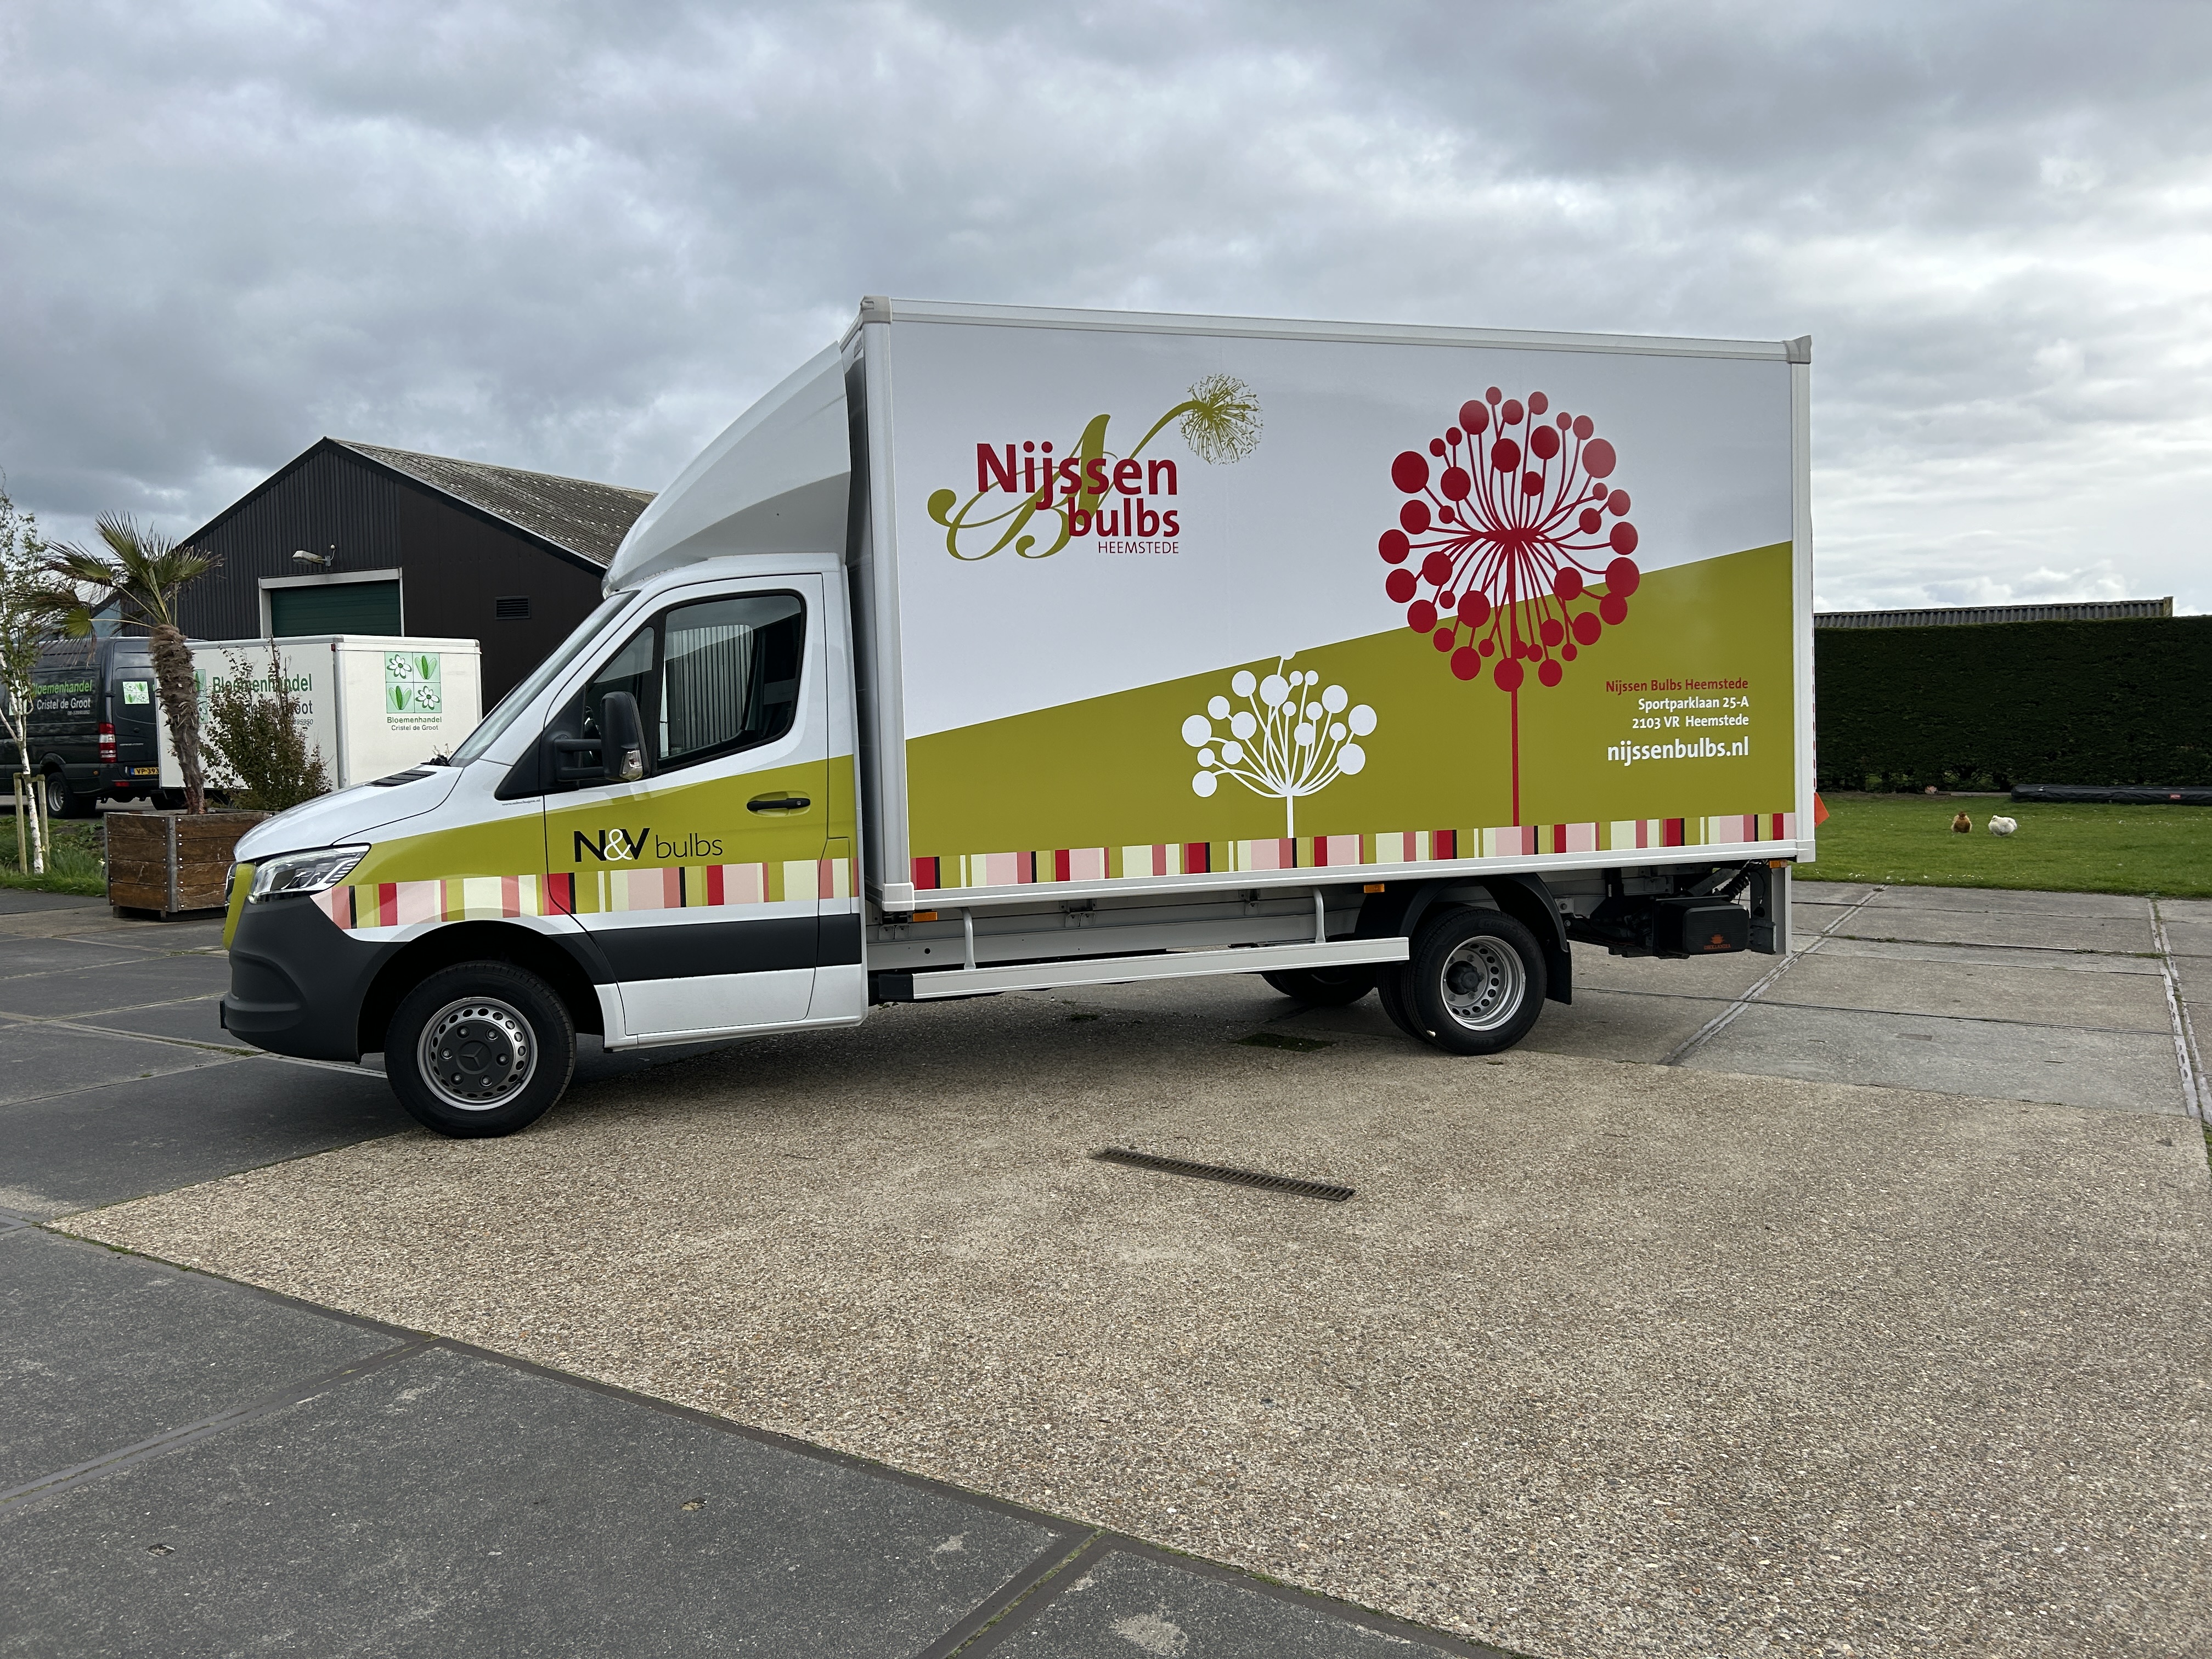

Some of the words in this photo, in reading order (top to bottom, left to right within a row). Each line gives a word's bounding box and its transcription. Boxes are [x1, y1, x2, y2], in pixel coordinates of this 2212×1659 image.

[977, 441, 1178, 510] Nijssen
[1067, 497, 1180, 538] bulbs
[1098, 541, 1180, 554] HEEMSTEDE
[212, 673, 313, 693] Bloeenhndel
[1606, 680, 1647, 696] Nijssen
[1651, 678, 1682, 691] Bulbs
[1685, 677, 1748, 690] Heemstede
[37, 698, 59, 710] Cristel
[60, 698, 69, 709] de
[70, 697, 91, 708] Groot
[1638, 696, 1720, 713] Sportparklaan
[1723, 696, 1749, 709] 25-A
[1632, 717, 1661, 730] 2103
[1663, 716, 1680, 727] VR
[1685, 713, 1750, 727] Heemstede
[1607, 736, 1749, 766] nijssenbulbs.nl
[574, 827, 651, 862] N&V
[656, 832, 723, 859] bulbs
